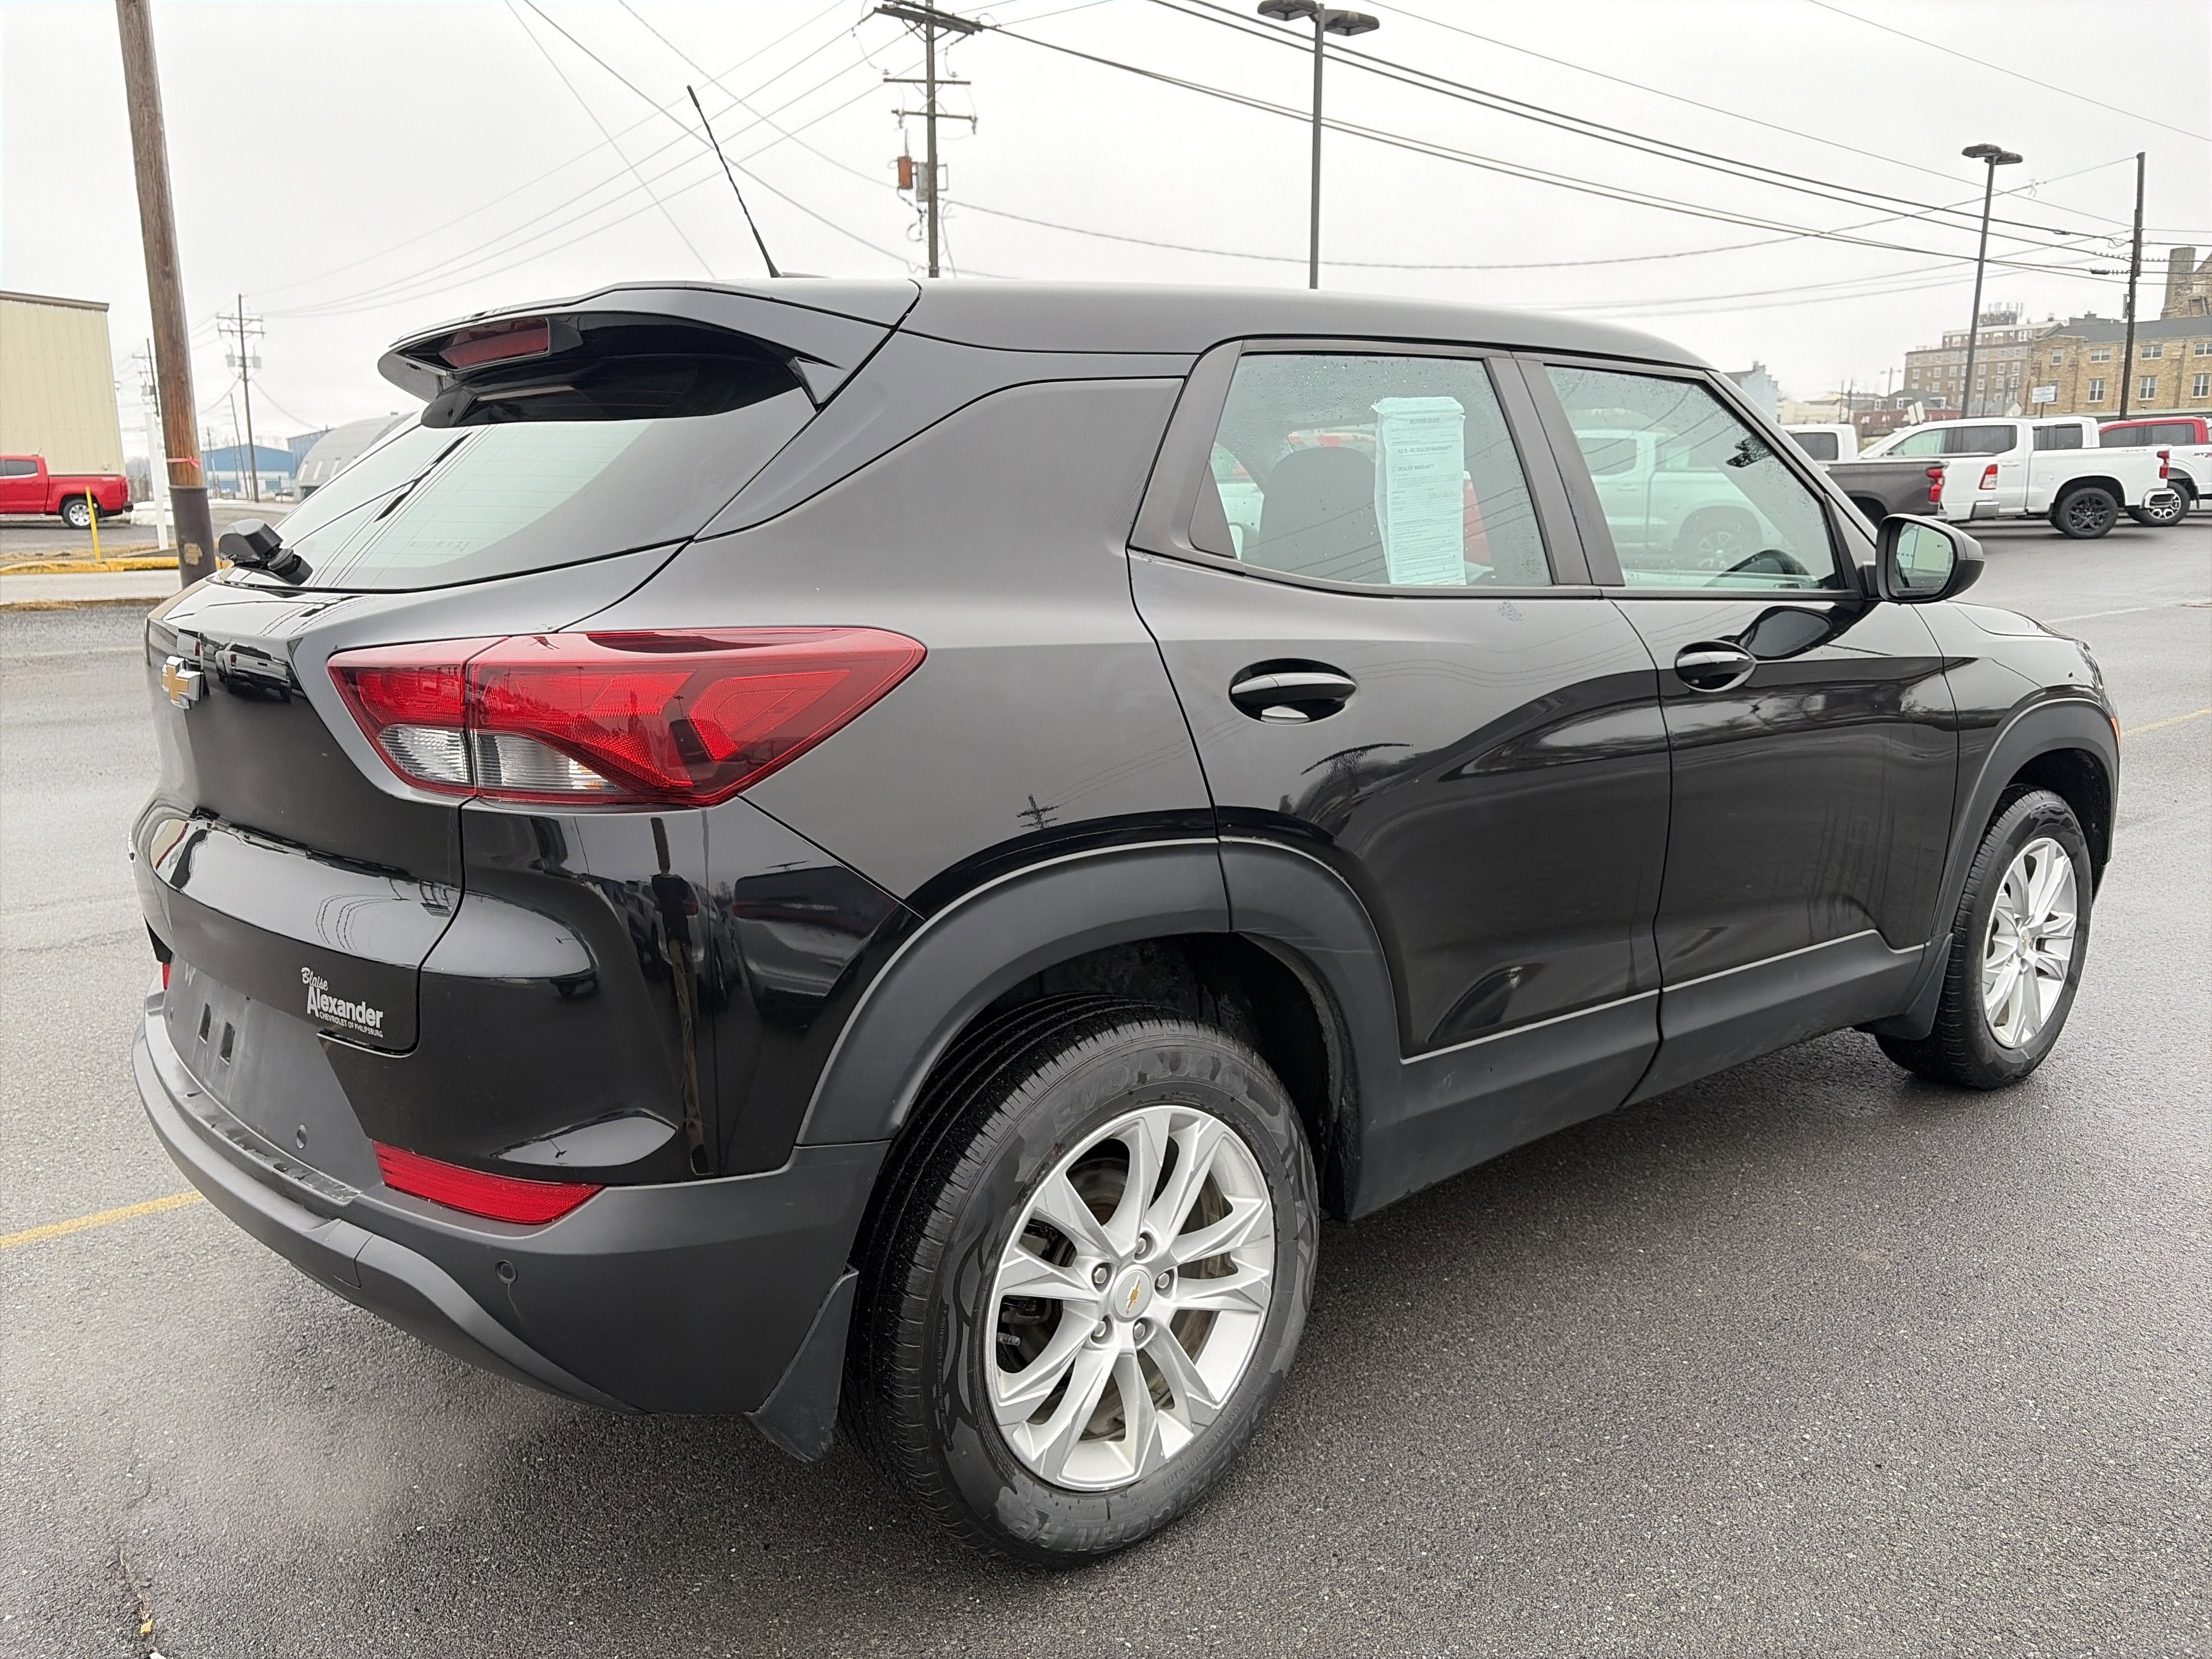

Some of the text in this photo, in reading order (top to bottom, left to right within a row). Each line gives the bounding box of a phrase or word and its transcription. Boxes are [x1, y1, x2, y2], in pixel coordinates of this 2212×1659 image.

[301, 967, 329, 991] Blaise
[307, 986, 383, 1029] Alexander
[319, 1011, 347, 1028] CHEVROLET
[347, 1021, 354, 1029] OF
